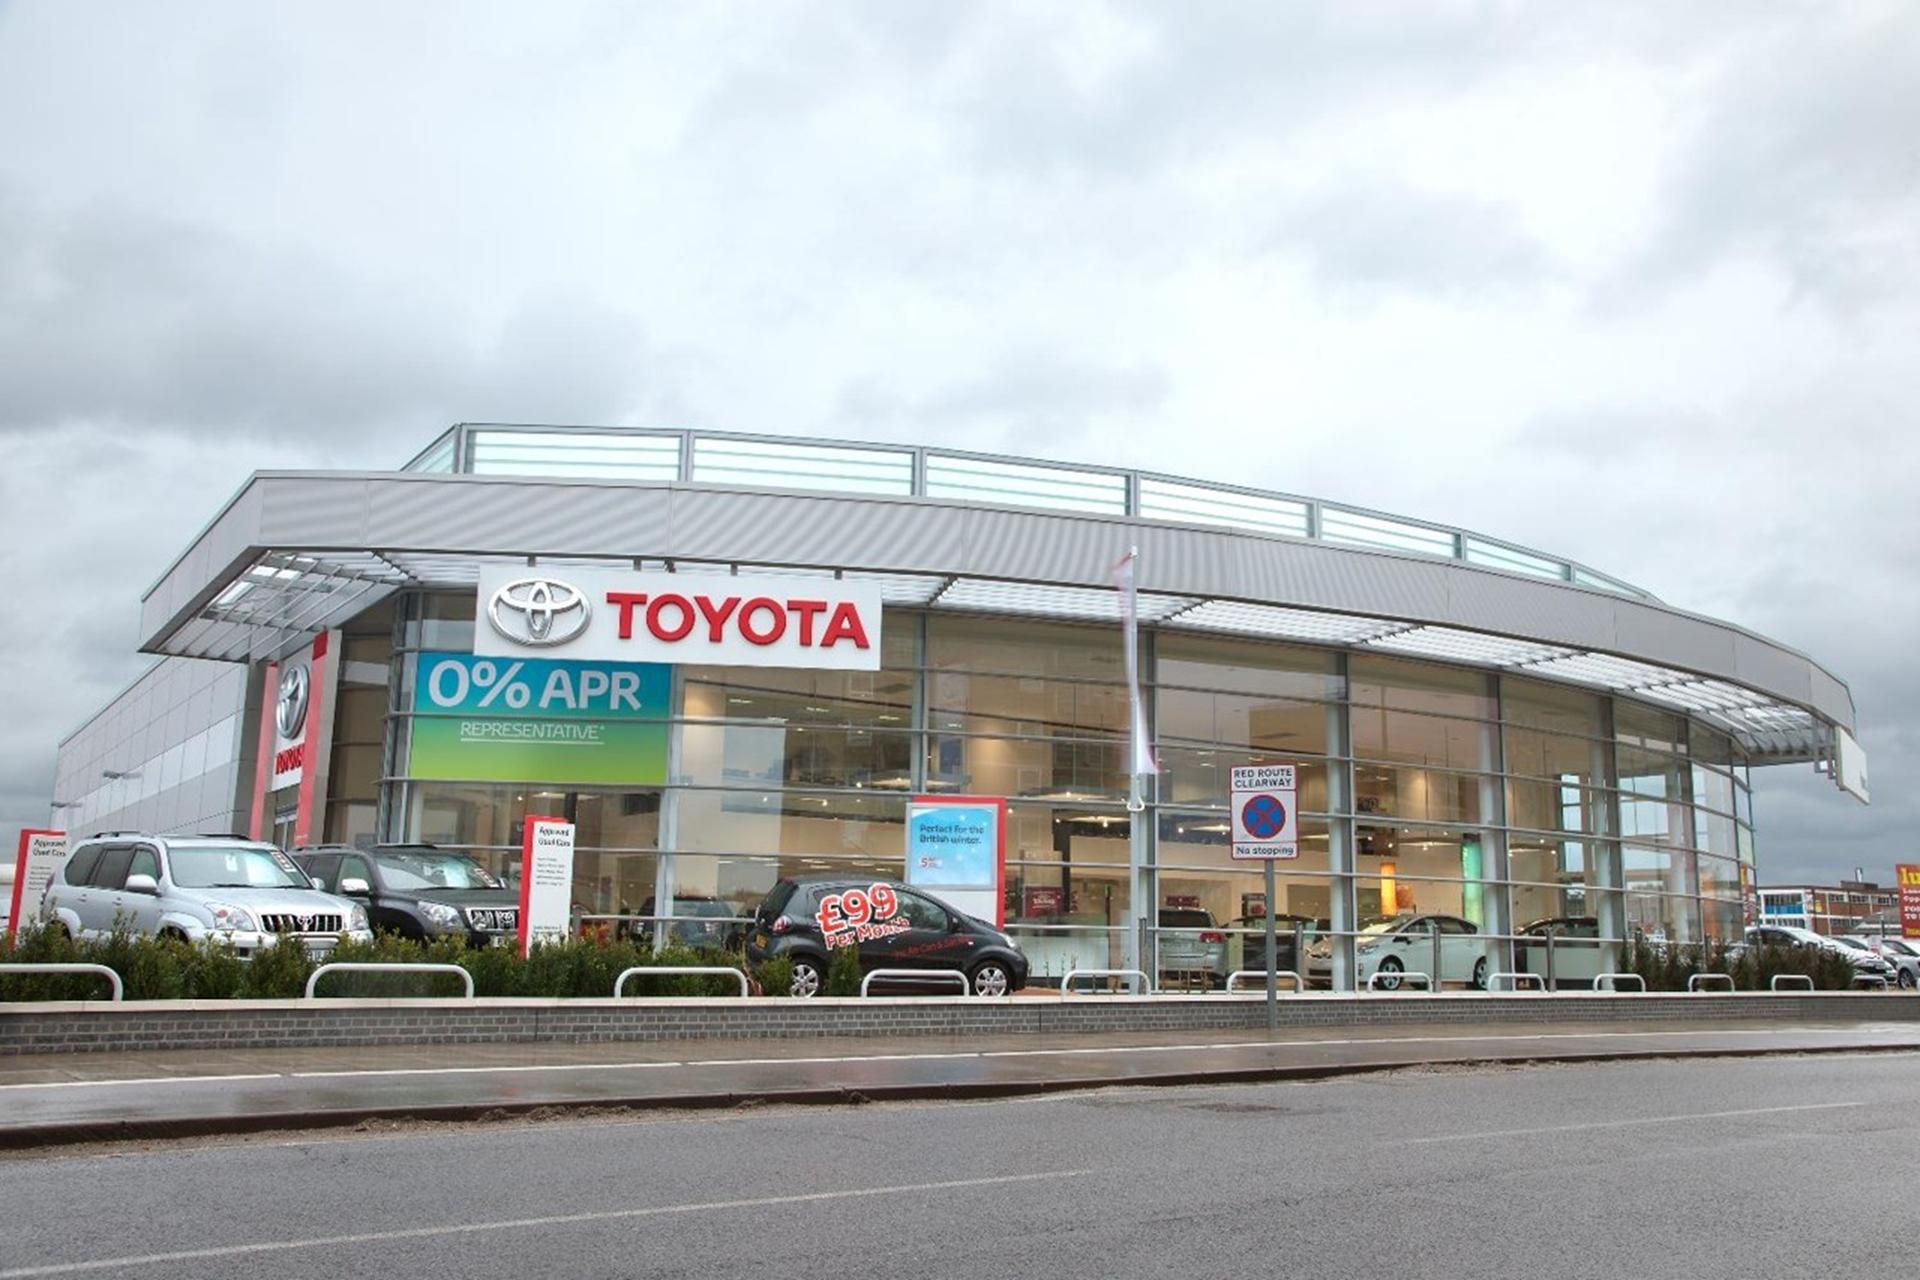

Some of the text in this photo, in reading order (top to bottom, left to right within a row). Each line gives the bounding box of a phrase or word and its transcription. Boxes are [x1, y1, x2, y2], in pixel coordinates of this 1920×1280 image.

[605, 592, 869, 649] TOYOTA
[428, 660, 641, 711] 0% APR
[275, 743, 304, 775] TOYOT
[1233, 768, 1293, 778] RED ROUTE
[1234, 779, 1292, 789] CLEARWAY
[920, 823, 985, 834] Perfect for the
[920, 834, 949, 844] British
[1236, 846, 1294, 856] No stopping
[816, 883, 898, 934] £99
[824, 917, 911, 951] Per Month
